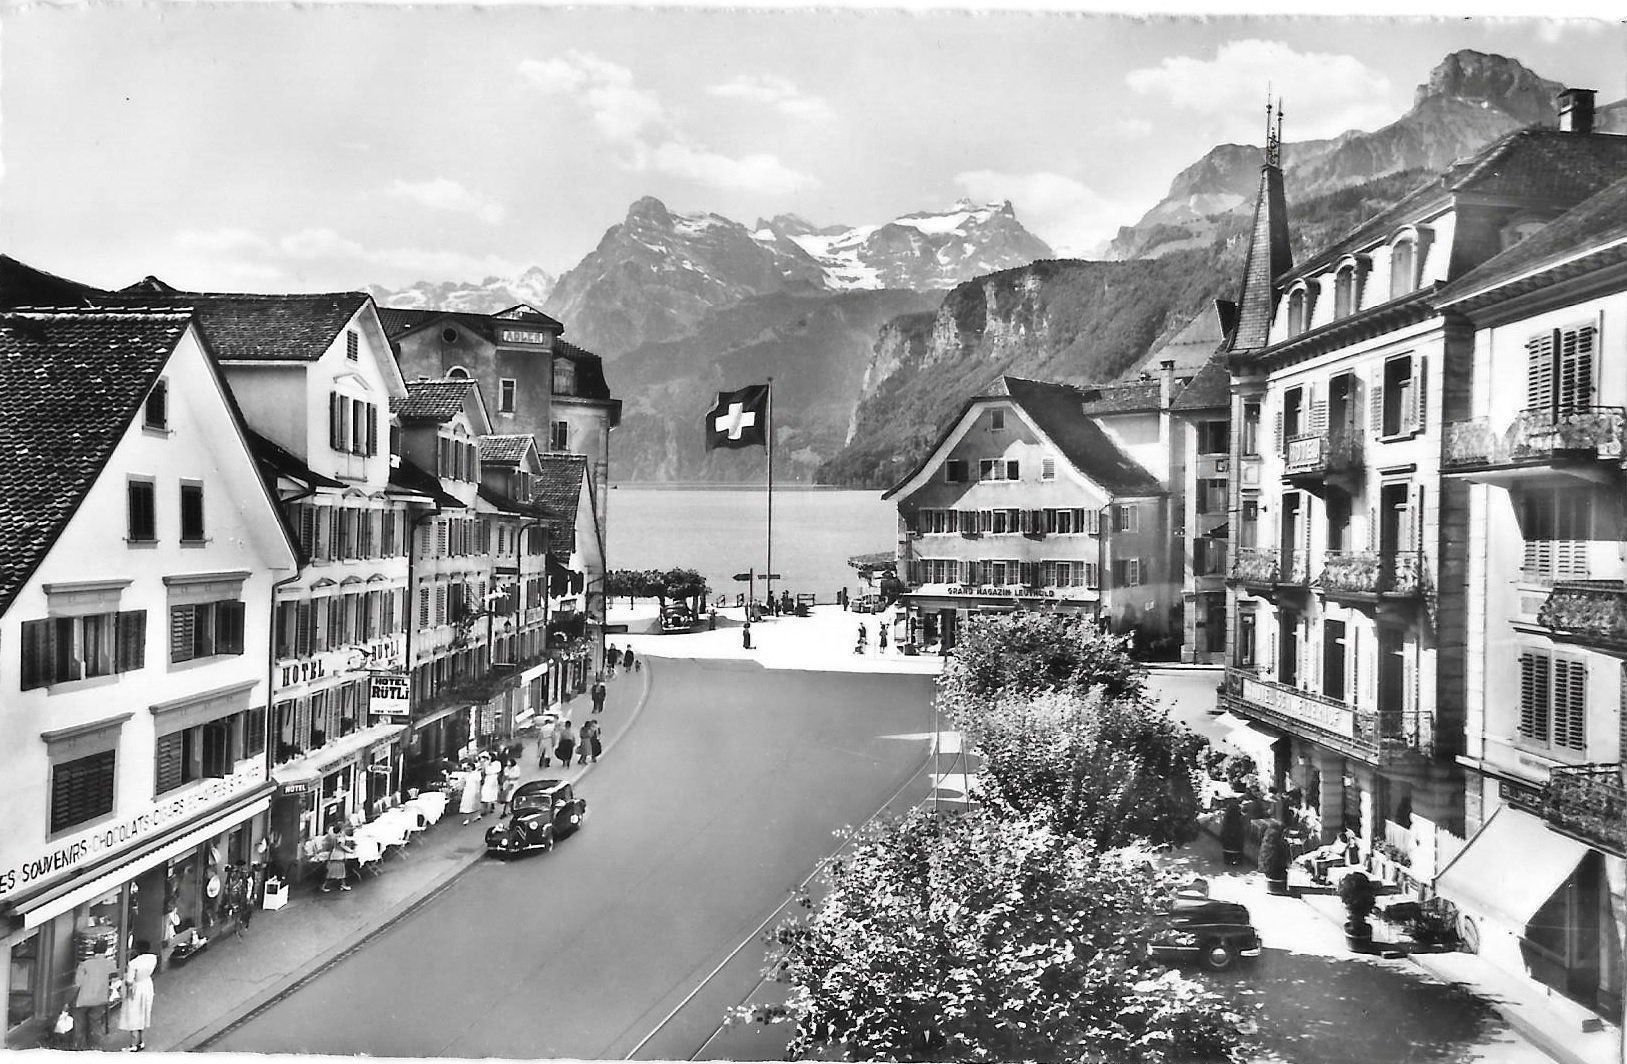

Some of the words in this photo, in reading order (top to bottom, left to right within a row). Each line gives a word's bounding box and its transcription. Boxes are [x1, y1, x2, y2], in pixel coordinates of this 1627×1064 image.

[947, 587, 973, 595] GRAND
[282, 659, 325, 688] HOTEL
[375, 678, 408, 687] HOTEL
[284, 784, 307, 794] HOTEL
[22, 839, 88, 883] SOUVENIRS
[92, 815, 150, 853] CHOCOLATS
